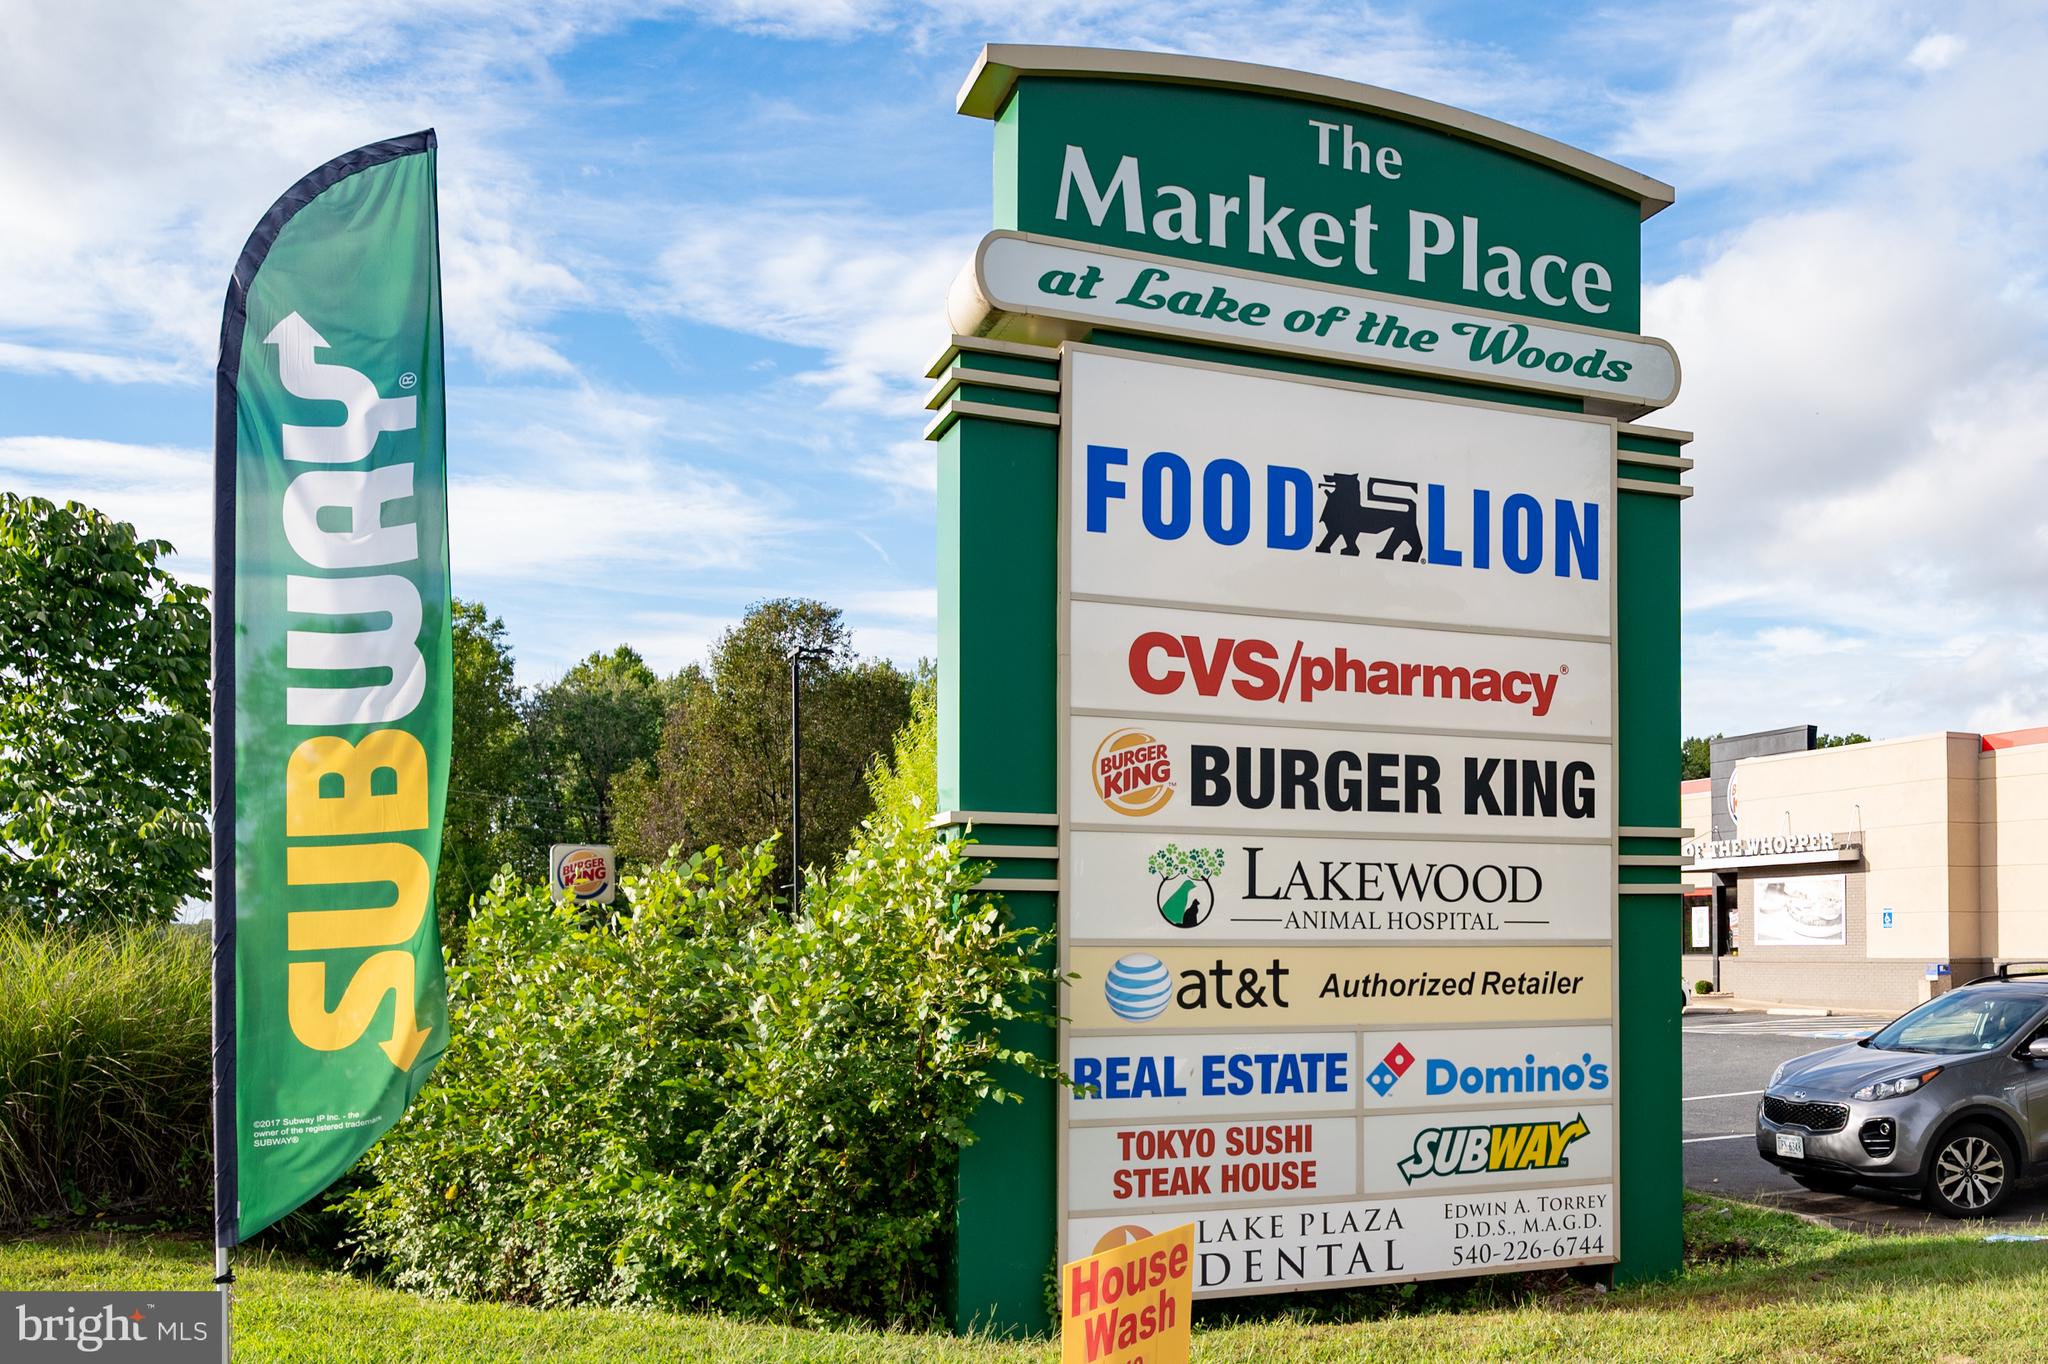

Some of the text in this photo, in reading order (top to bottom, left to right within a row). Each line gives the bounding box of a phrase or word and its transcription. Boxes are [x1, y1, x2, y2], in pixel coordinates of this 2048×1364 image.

[1308, 119, 1403, 181] The
[1055, 144, 1614, 315] Market Place
[1037, 266, 1634, 384] at Lake of the Woods
[1086, 444, 1600, 581] FOOD LION
[263, 311, 432, 1073] SUBWAY
[1128, 631, 1559, 717] CVS/pharmacy
[1101, 744, 1168, 775] BURGER
[1104, 760, 1171, 799] KING
[1190, 744, 1597, 819] BURGER KING
[563, 858, 605, 876] BURGER
[1711, 839, 1745, 858] THE
[1745, 831, 1835, 856] WHOPPER
[1242, 847, 1543, 903] LAKEWOOD
[1284, 911, 1499, 931] ANIMAL HOSPITAL
[1176, 959, 1584, 1011] at&t Authorized Retailer
[1073, 1053, 1348, 1100] REAL ESTATE
[1426, 1053, 1609, 1096] Domino's
[253, 1130, 279, 1138] owner
[280, 1127, 290, 1136] of
[290, 1126, 304, 1135] the
[305, 1121, 344, 1133] registered
[282, 1117, 315, 1127] Subway
[347, 1111, 360, 1119] the
[1117, 1124, 1312, 1161] TOKYO SUSHI
[1397, 1112, 1590, 1186] SUBWAY
[1113, 1160, 1317, 1199] STEAK HOUSE
[1198, 1207, 1405, 1244] LAKE PLAZA
[1444, 1194, 1607, 1219] EDWIN A. TORREY
[1455, 1213, 1602, 1239] D.D.S., M.A.G.D.
[1198, 1239, 1405, 1287] DENTAL
[1452, 1234, 1605, 1267] 540-226-6744
[1071, 1243, 1188, 1318] House
[1084, 1288, 1176, 1363] Wash
